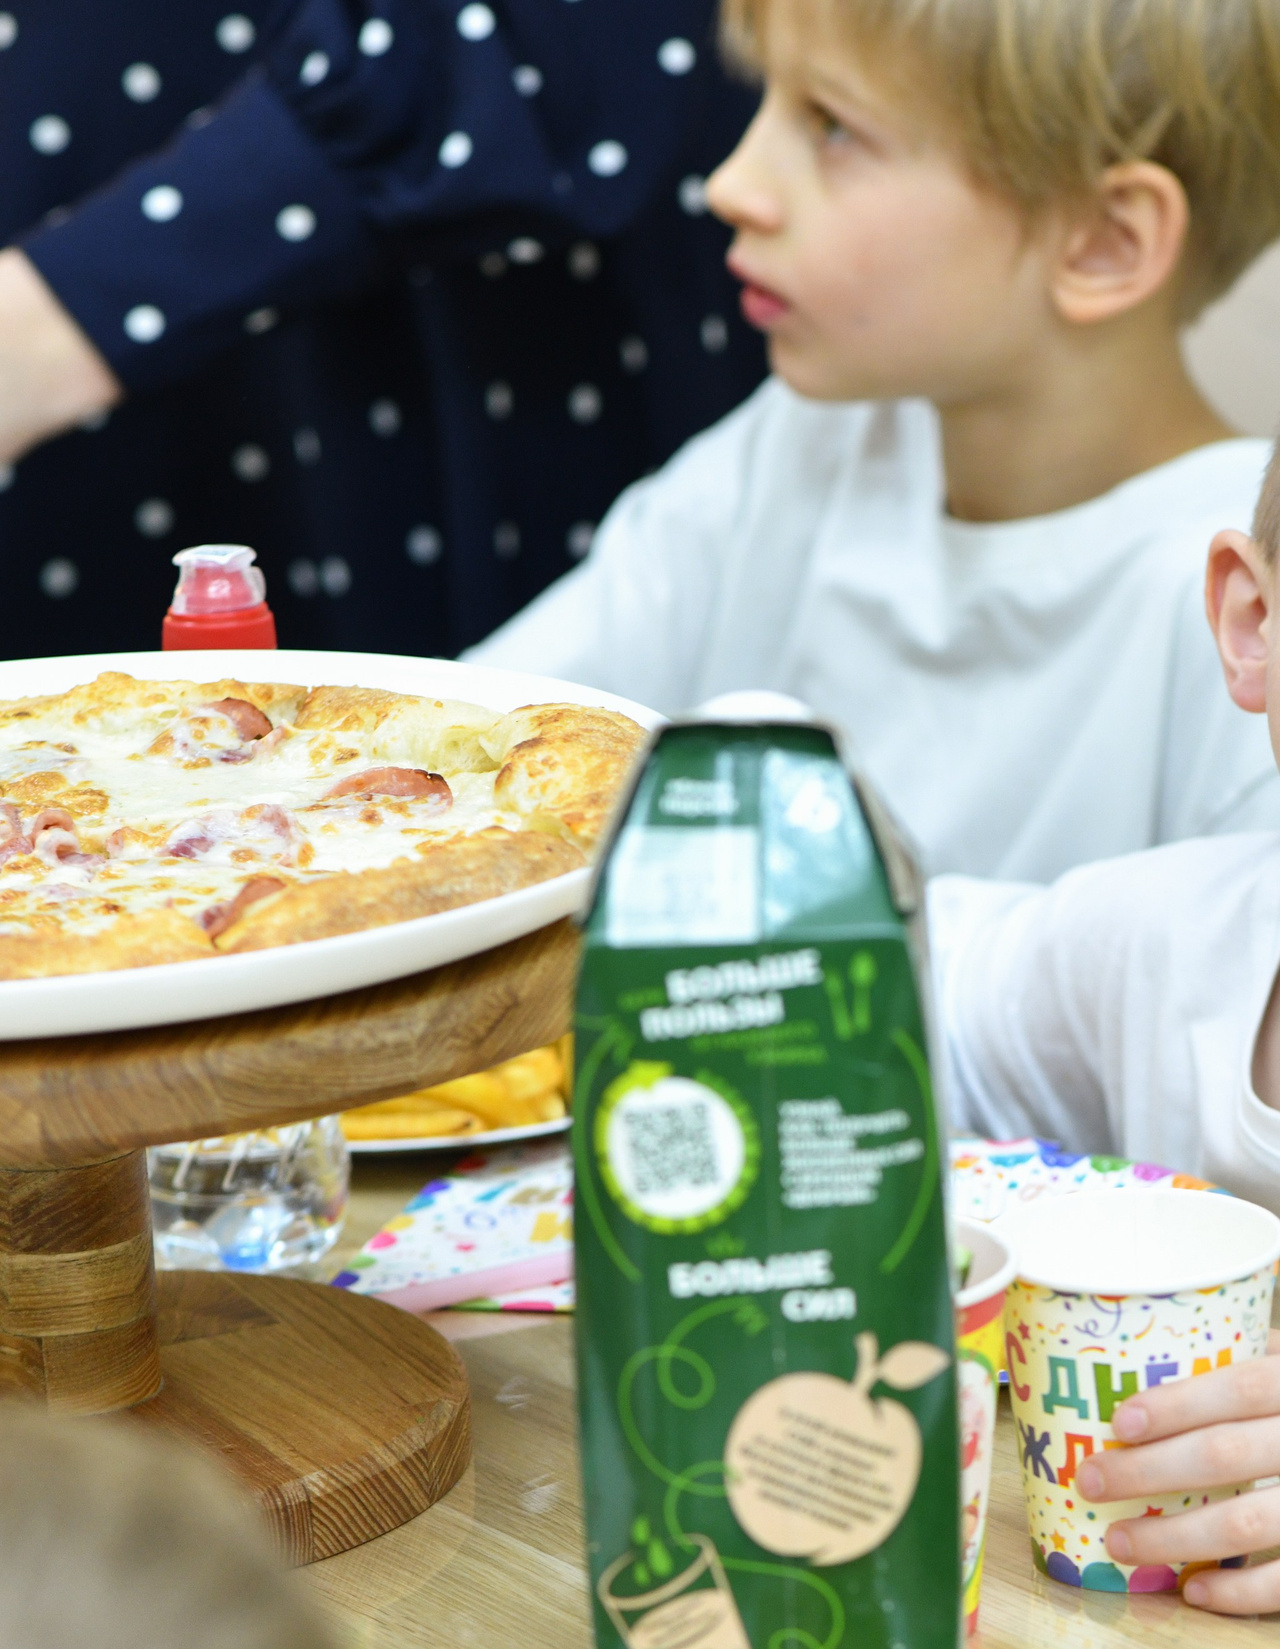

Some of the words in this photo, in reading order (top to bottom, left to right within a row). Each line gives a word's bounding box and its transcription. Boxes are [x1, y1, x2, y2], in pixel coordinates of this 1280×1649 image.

[666, 948, 823, 1004] БОЛЬШЕ
[640, 992, 785, 1041] ПОЛЬЗЫ
[668, 1250, 834, 1299] БОЛЬШЕ
[781, 1287, 857, 1323] СИЛ
[1006, 1331, 1031, 1402] С
[1041, 1347, 1232, 1423] ДН
[1018, 1418, 1128, 1489] ЖД
